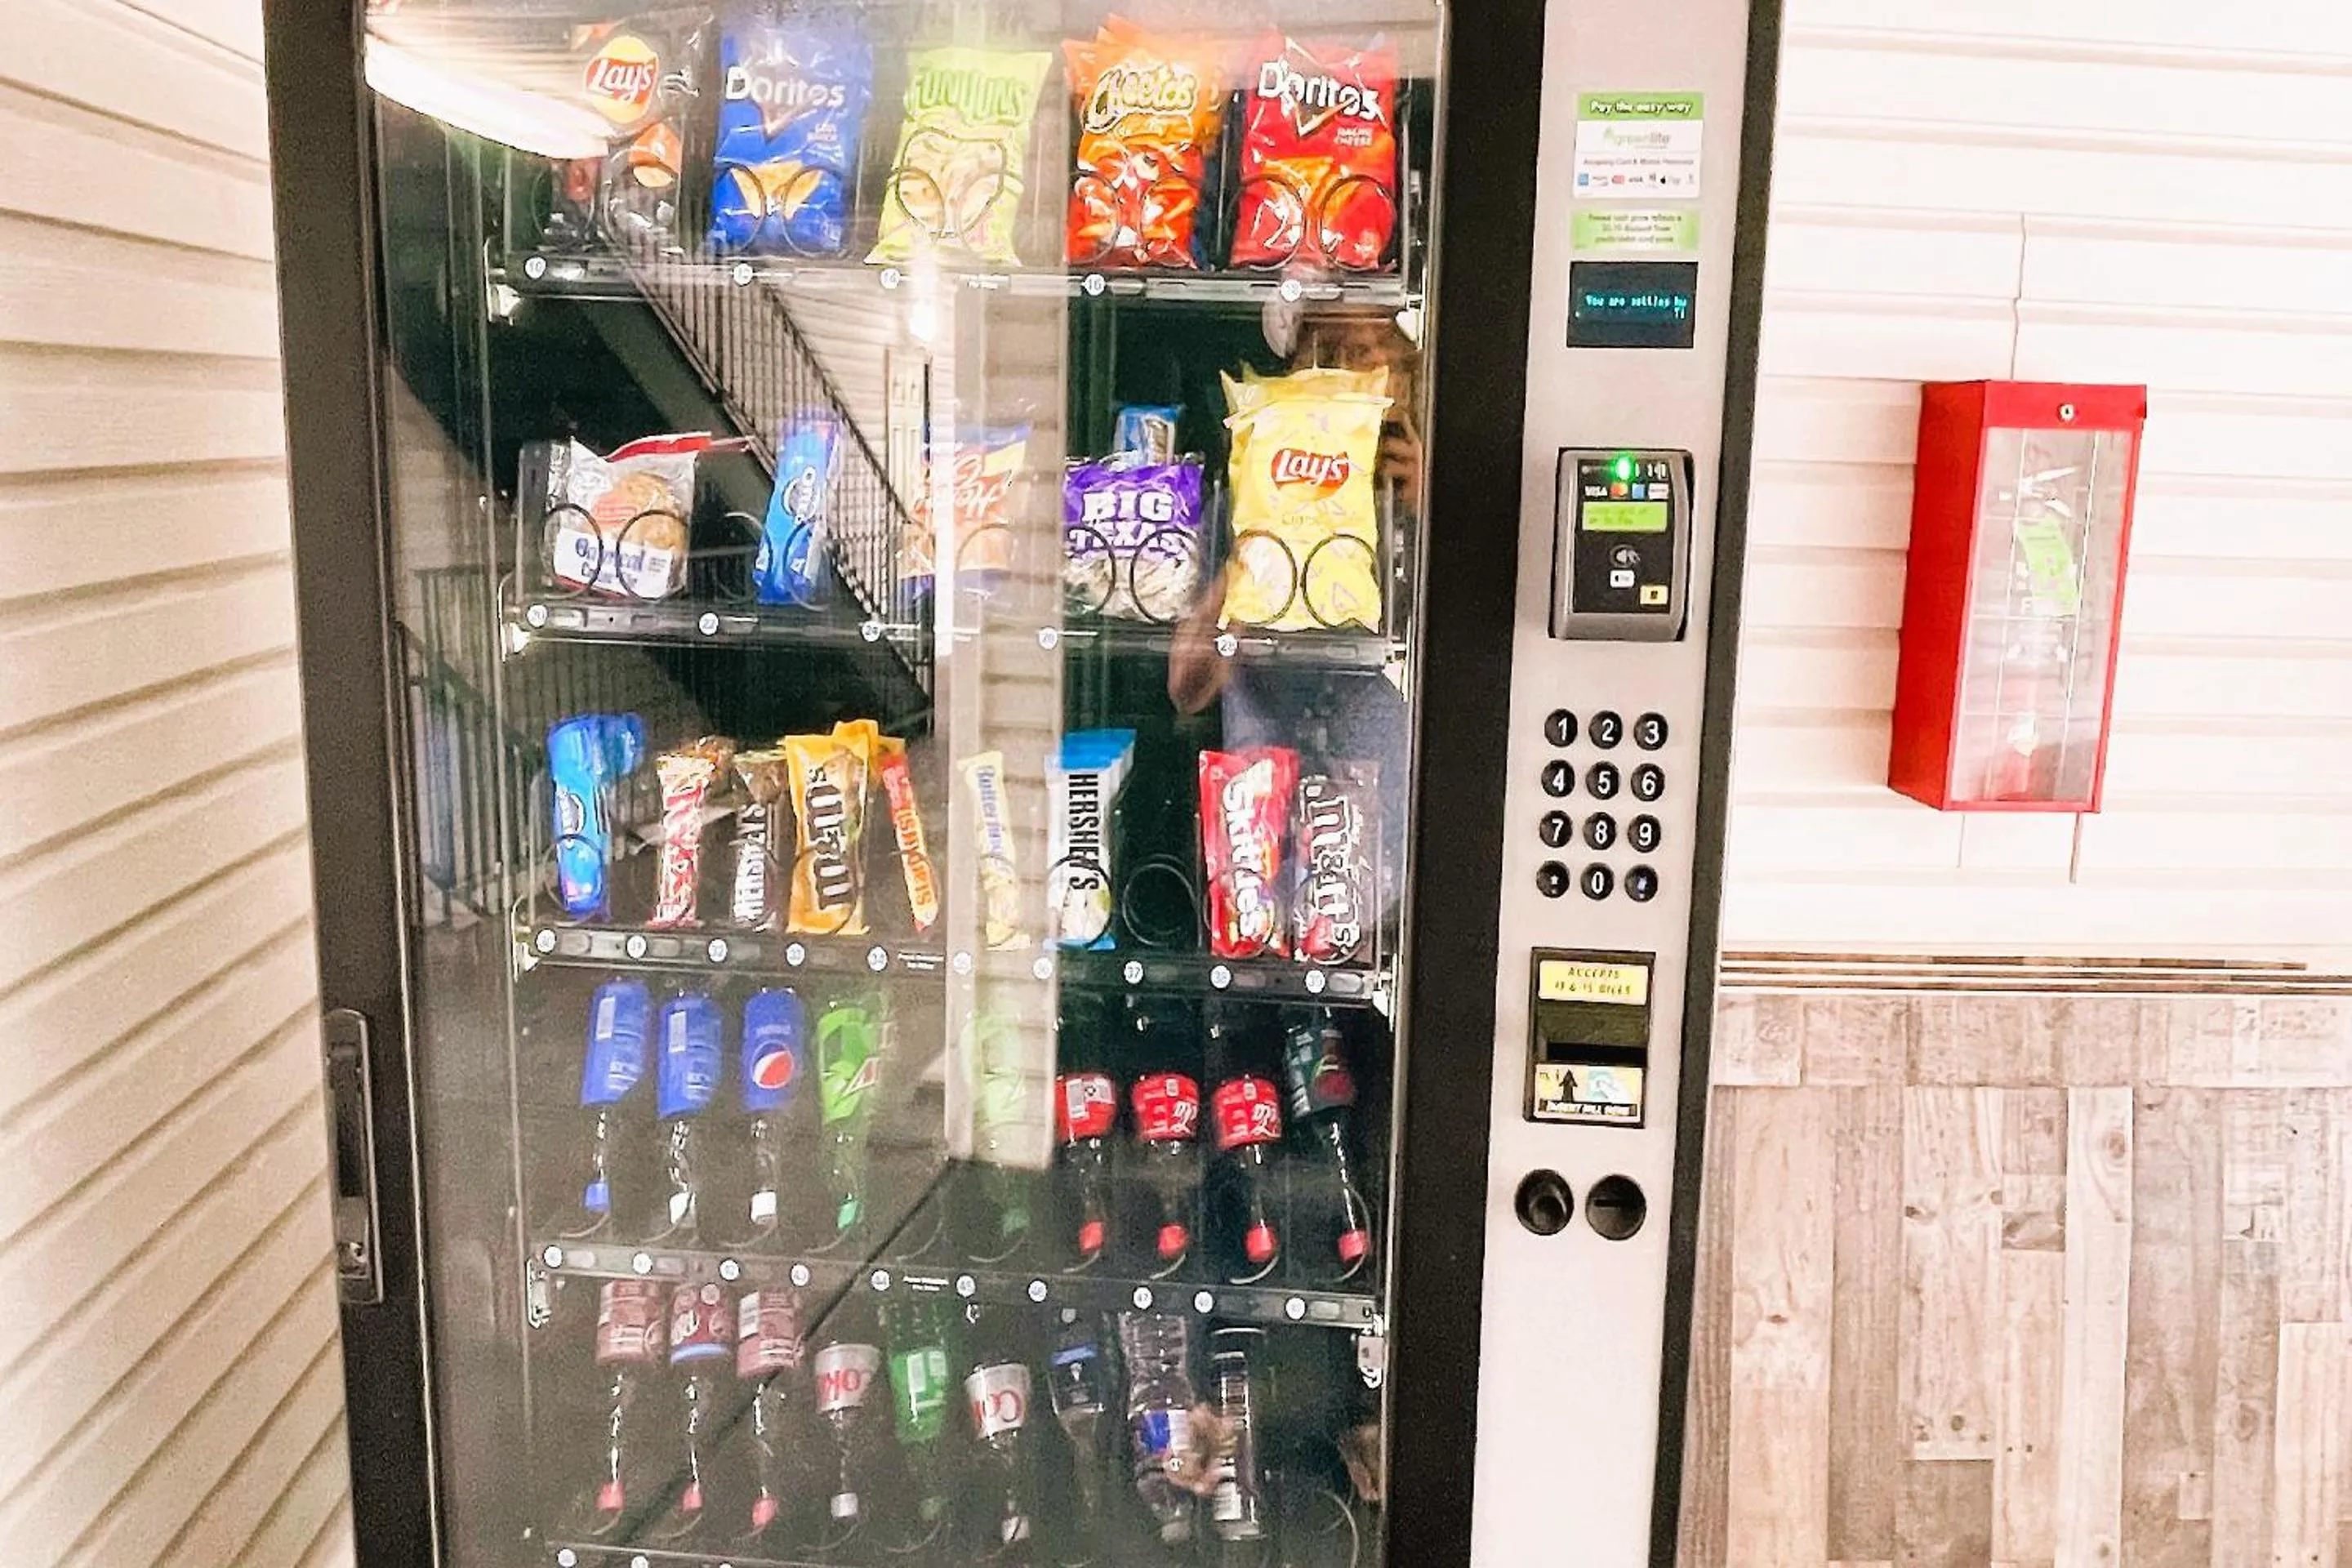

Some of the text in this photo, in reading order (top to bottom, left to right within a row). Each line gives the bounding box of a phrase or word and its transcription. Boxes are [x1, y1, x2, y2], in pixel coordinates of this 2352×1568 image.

[725, 65, 845, 107] Doritos
[1258, 60, 1379, 120] Doritos
[1589, 100, 1693, 115] Pay the easy way
[1585, 295, 1604, 306] You
[1608, 297, 1625, 306] are
[1081, 490, 1174, 523] BIG
[1067, 520, 1182, 555] TEXAS
[1557, 717, 1567, 741] 1
[1601, 719, 1615, 742] 2
[1644, 720, 1659, 744] 3
[1552, 768, 1565, 791] 4
[1597, 771, 1610, 795] 5
[1642, 771, 1656, 795] 6
[1069, 774, 1099, 890] HERSHEY'S
[1552, 818, 1563, 841] 7
[1595, 820, 1607, 844] 8
[1638, 822, 1651, 846] 9
[1592, 871, 1604, 894] 0
